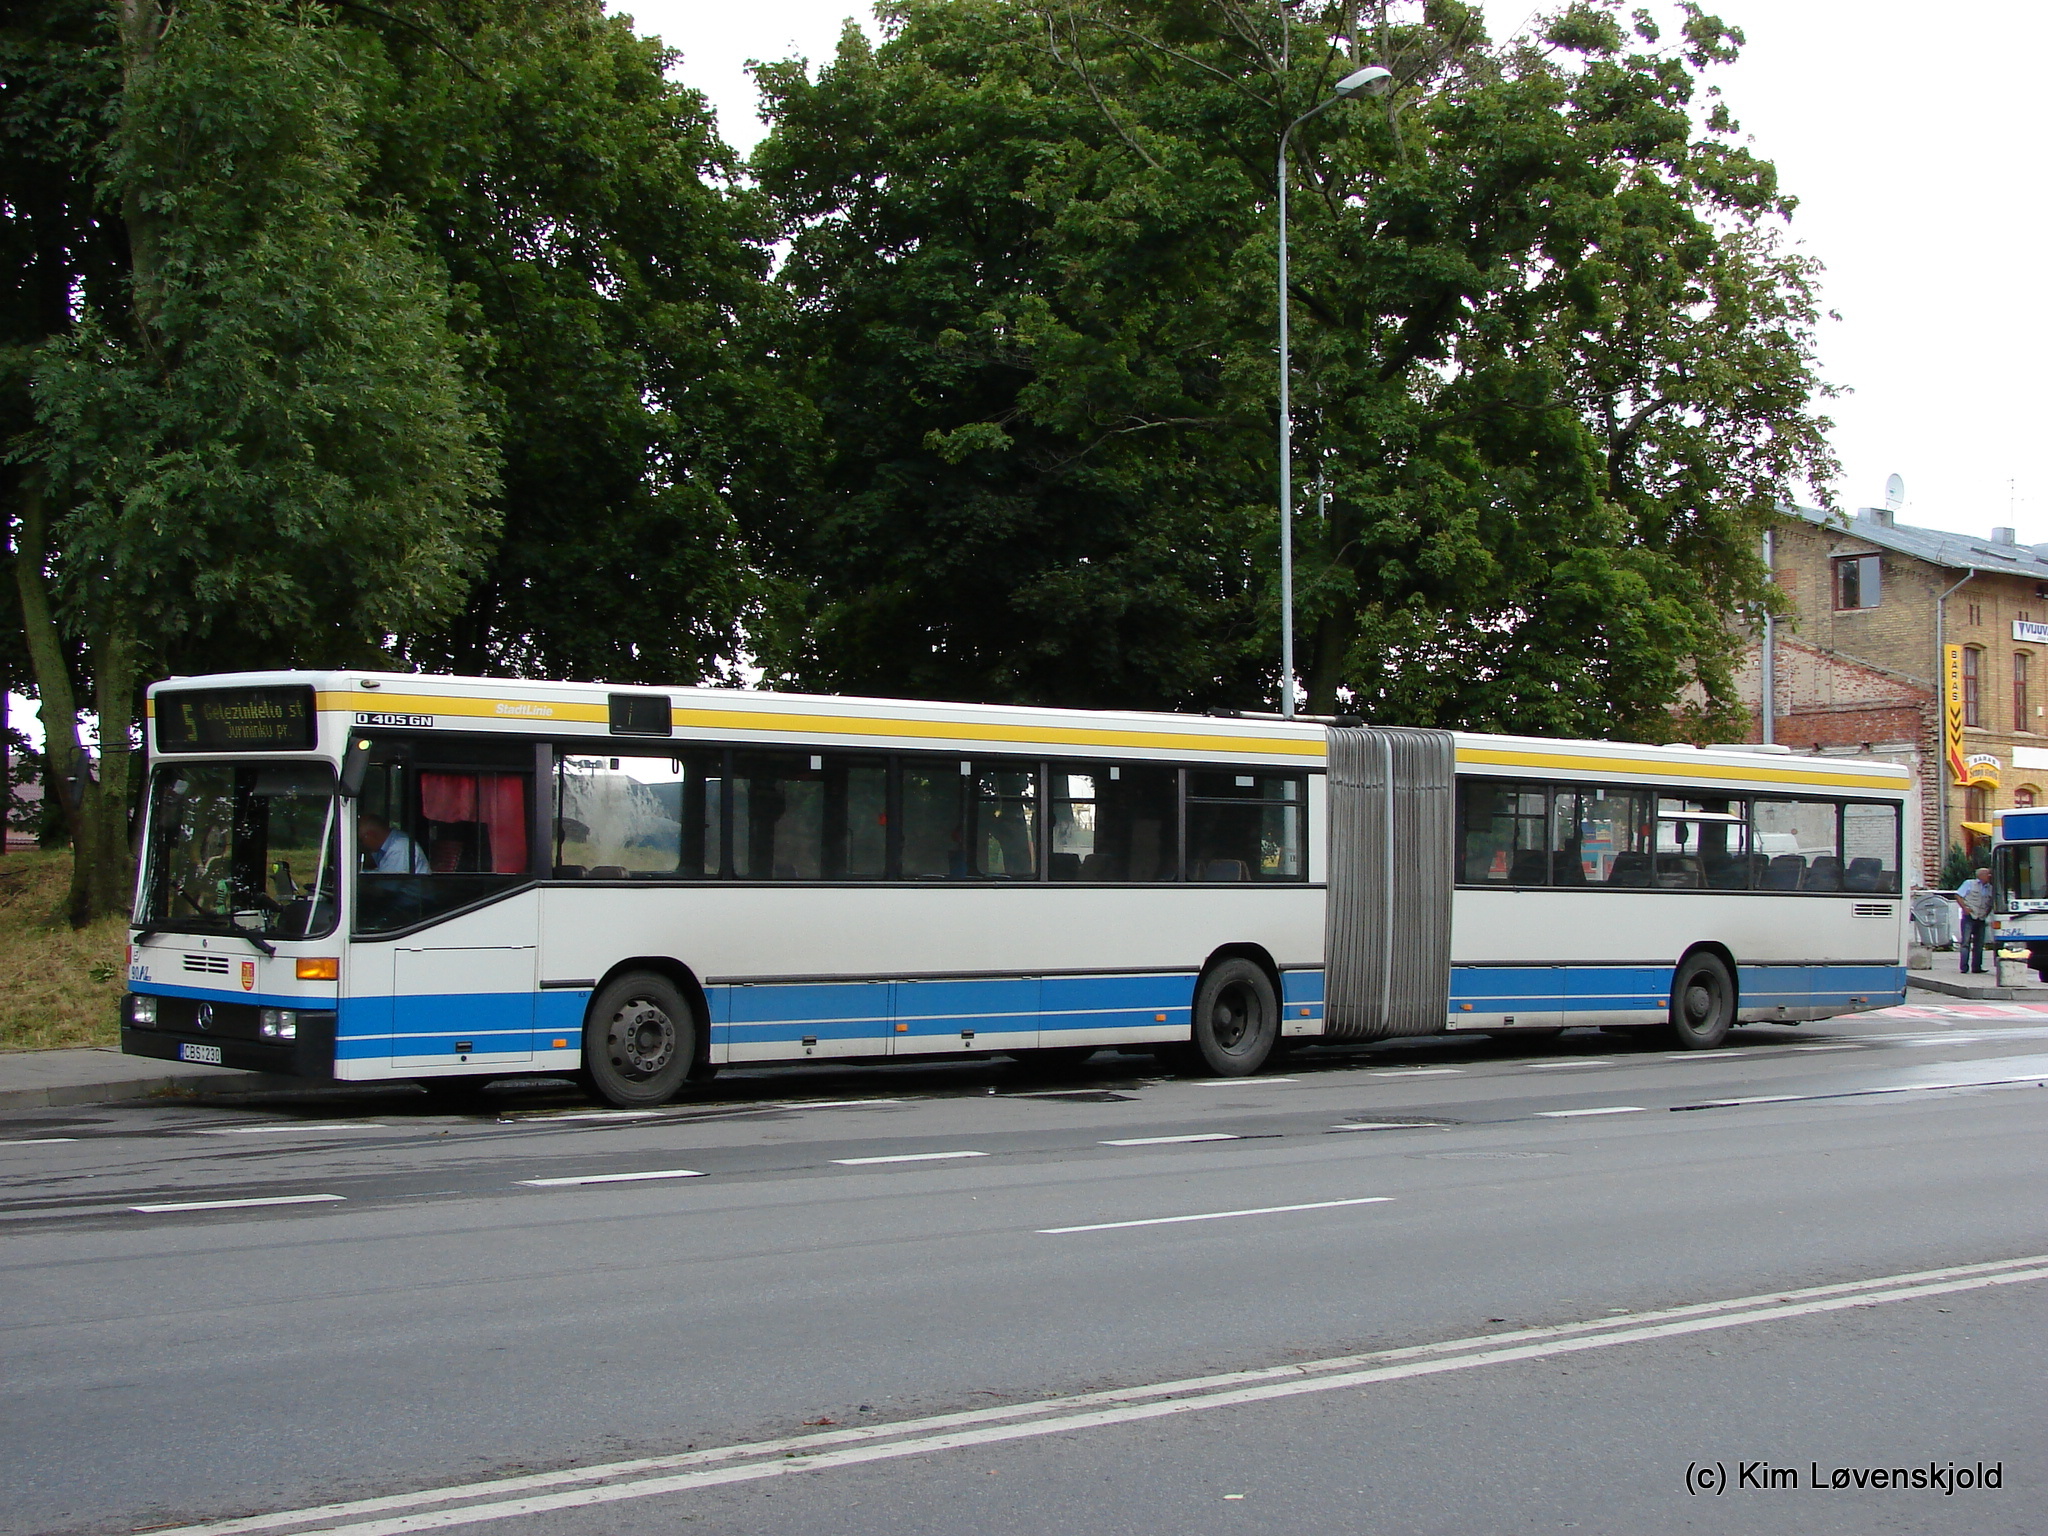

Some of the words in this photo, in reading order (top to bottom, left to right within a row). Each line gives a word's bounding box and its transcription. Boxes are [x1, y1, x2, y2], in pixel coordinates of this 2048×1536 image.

[1950, 650, 1959, 702] BARAS
[495, 703, 554, 717] StadtLinie
[182, 703, 198, 742] 5
[371, 714, 407, 726] 405
[408, 715, 433, 727] GN
[2010, 901, 2019, 911] 8
[185, 1044, 201, 1060] CBS
[205, 1047, 220, 1062] 230
